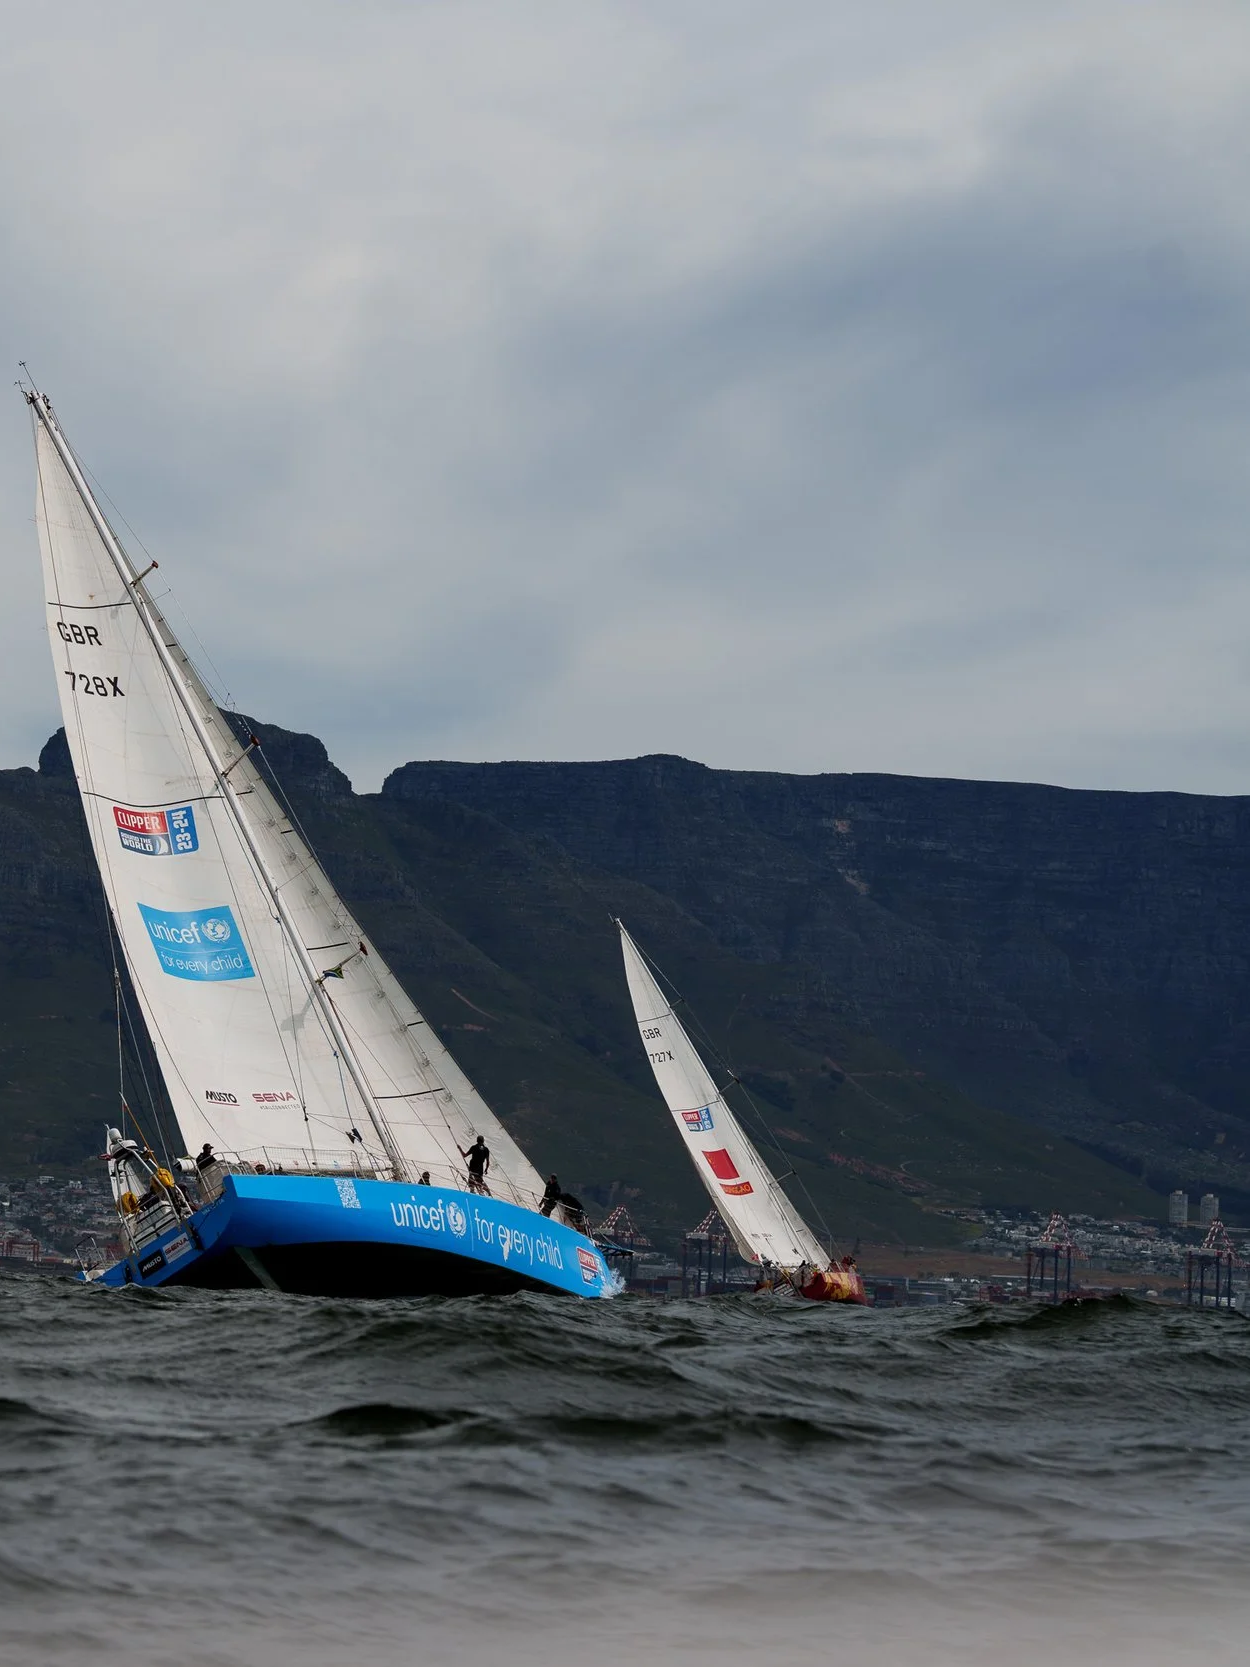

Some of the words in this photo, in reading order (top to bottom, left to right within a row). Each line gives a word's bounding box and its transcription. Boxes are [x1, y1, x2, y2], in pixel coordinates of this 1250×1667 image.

[57, 621, 103, 646] GBR
[64, 671, 125, 697] 728X
[117, 811, 161, 830] CLIPPER
[122, 838, 154, 852] WORLD
[148, 921, 201, 943] unicef
[160, 951, 175, 967] for
[176, 959, 209, 974] every
[211, 953, 244, 971] child
[642, 1027, 662, 1040] GBR
[649, 1050, 675, 1064] 727X
[205, 1090, 238, 1103] MUSTO
[252, 1092, 296, 1103] SENA
[390, 1195, 446, 1232] unicef
[474, 1208, 494, 1244] for
[536, 1233, 564, 1270] child
[142, 1255, 162, 1272] MUSTO
